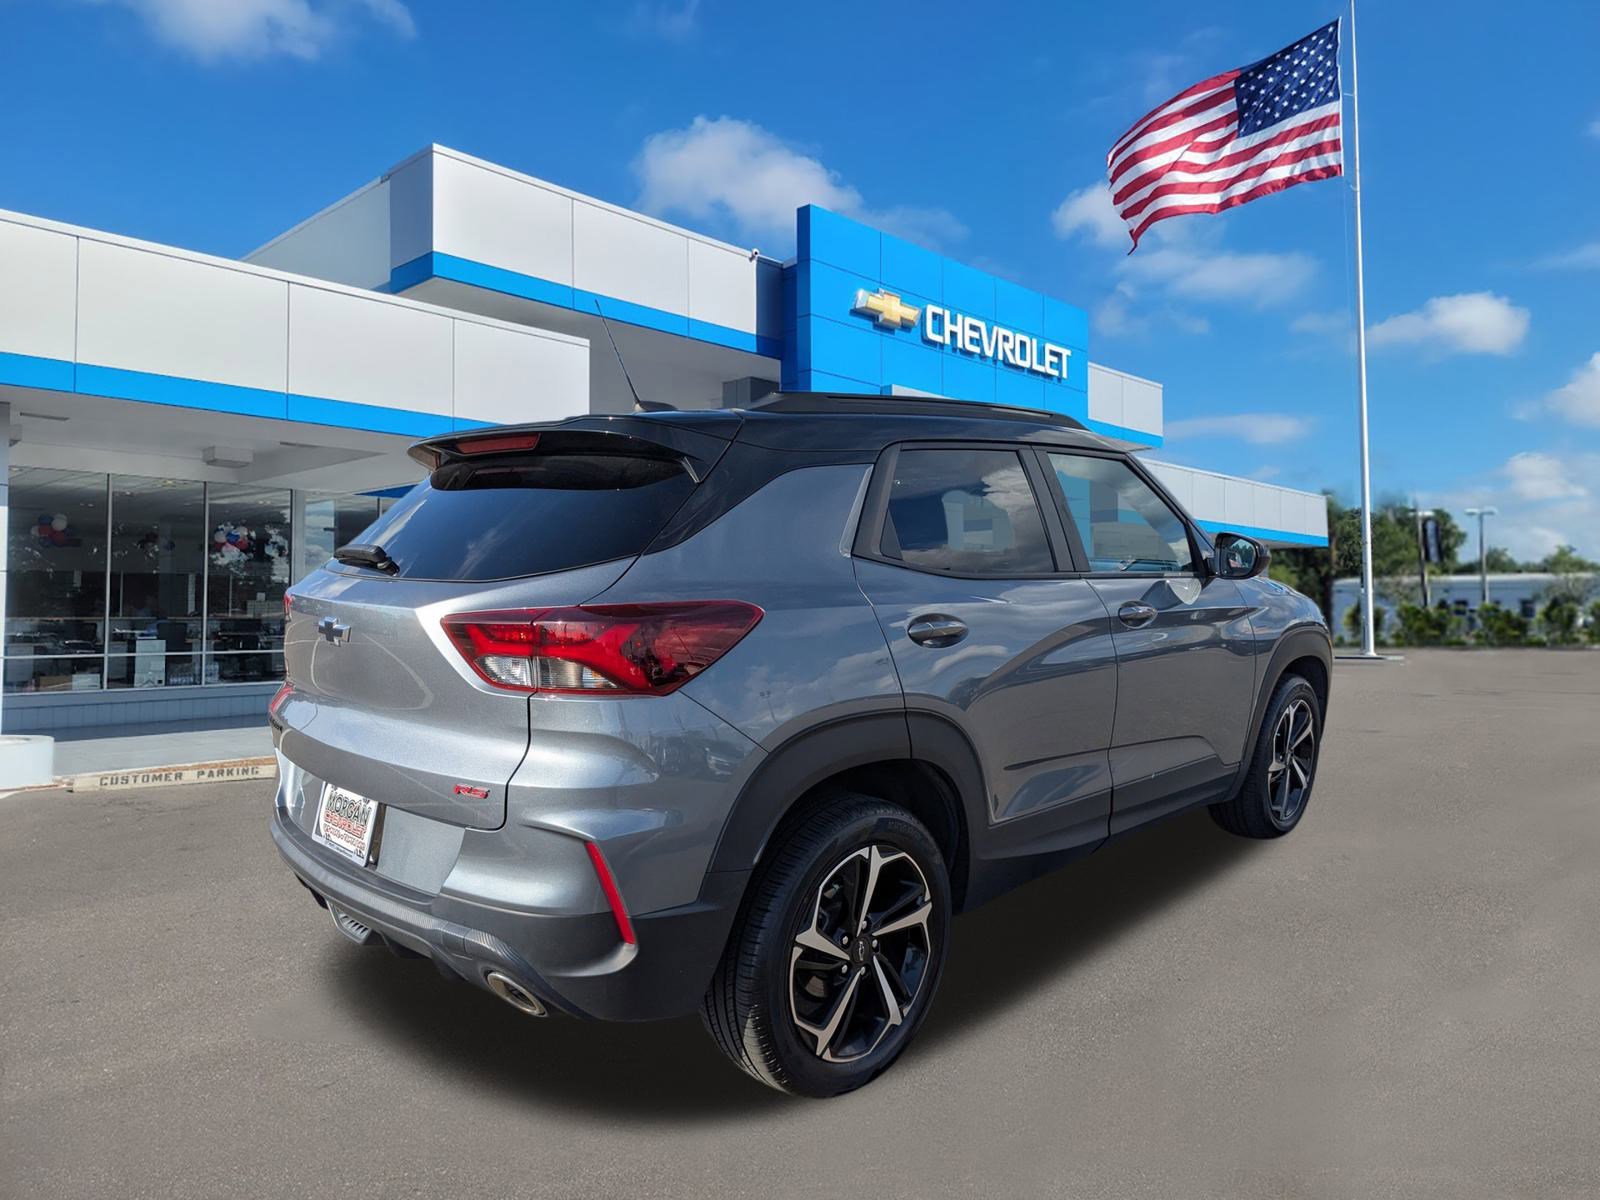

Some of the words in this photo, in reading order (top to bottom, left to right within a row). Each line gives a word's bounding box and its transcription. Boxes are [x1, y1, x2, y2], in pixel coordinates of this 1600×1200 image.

[925, 304, 1071, 378] CHEVROLET
[99, 772, 183, 787] CUSTOMER
[197, 766, 260, 779] PARKING
[454, 783, 489, 799] RS
[326, 790, 372, 826] MORGAN
